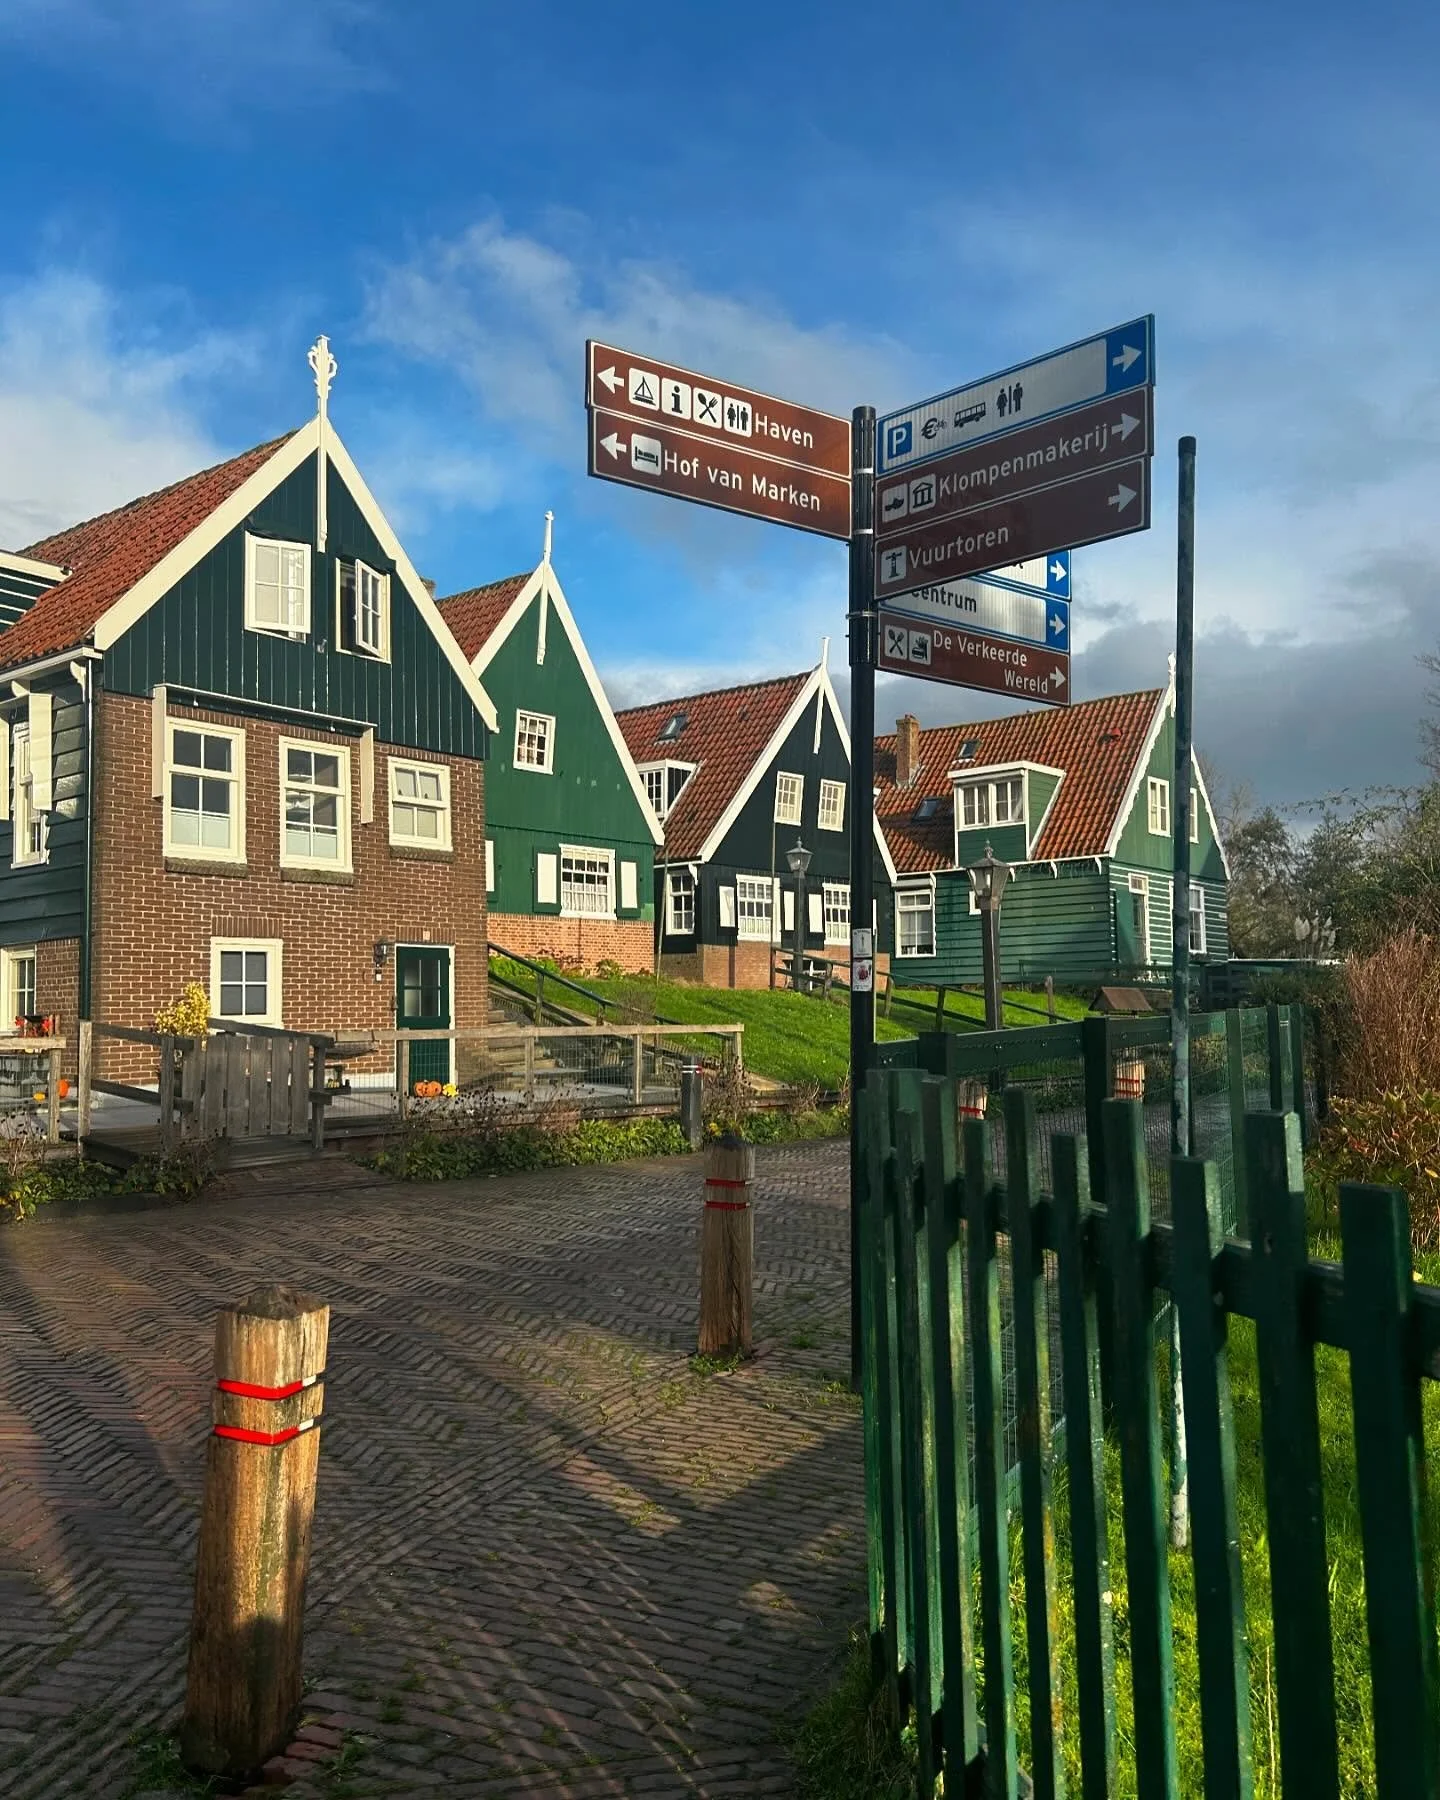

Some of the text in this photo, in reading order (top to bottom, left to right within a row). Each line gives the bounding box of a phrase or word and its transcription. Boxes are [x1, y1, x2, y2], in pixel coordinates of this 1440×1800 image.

[755, 413, 814, 449] Haven
[892, 427, 907, 455] P
[939, 423, 1108, 497] Klompenmakerij
[664, 450, 821, 512] Hof van Marken
[909, 526, 1009, 569] Vuurtoren
[933, 630, 1028, 667] De Verkeerde
[1004, 669, 1048, 694] Wereld
